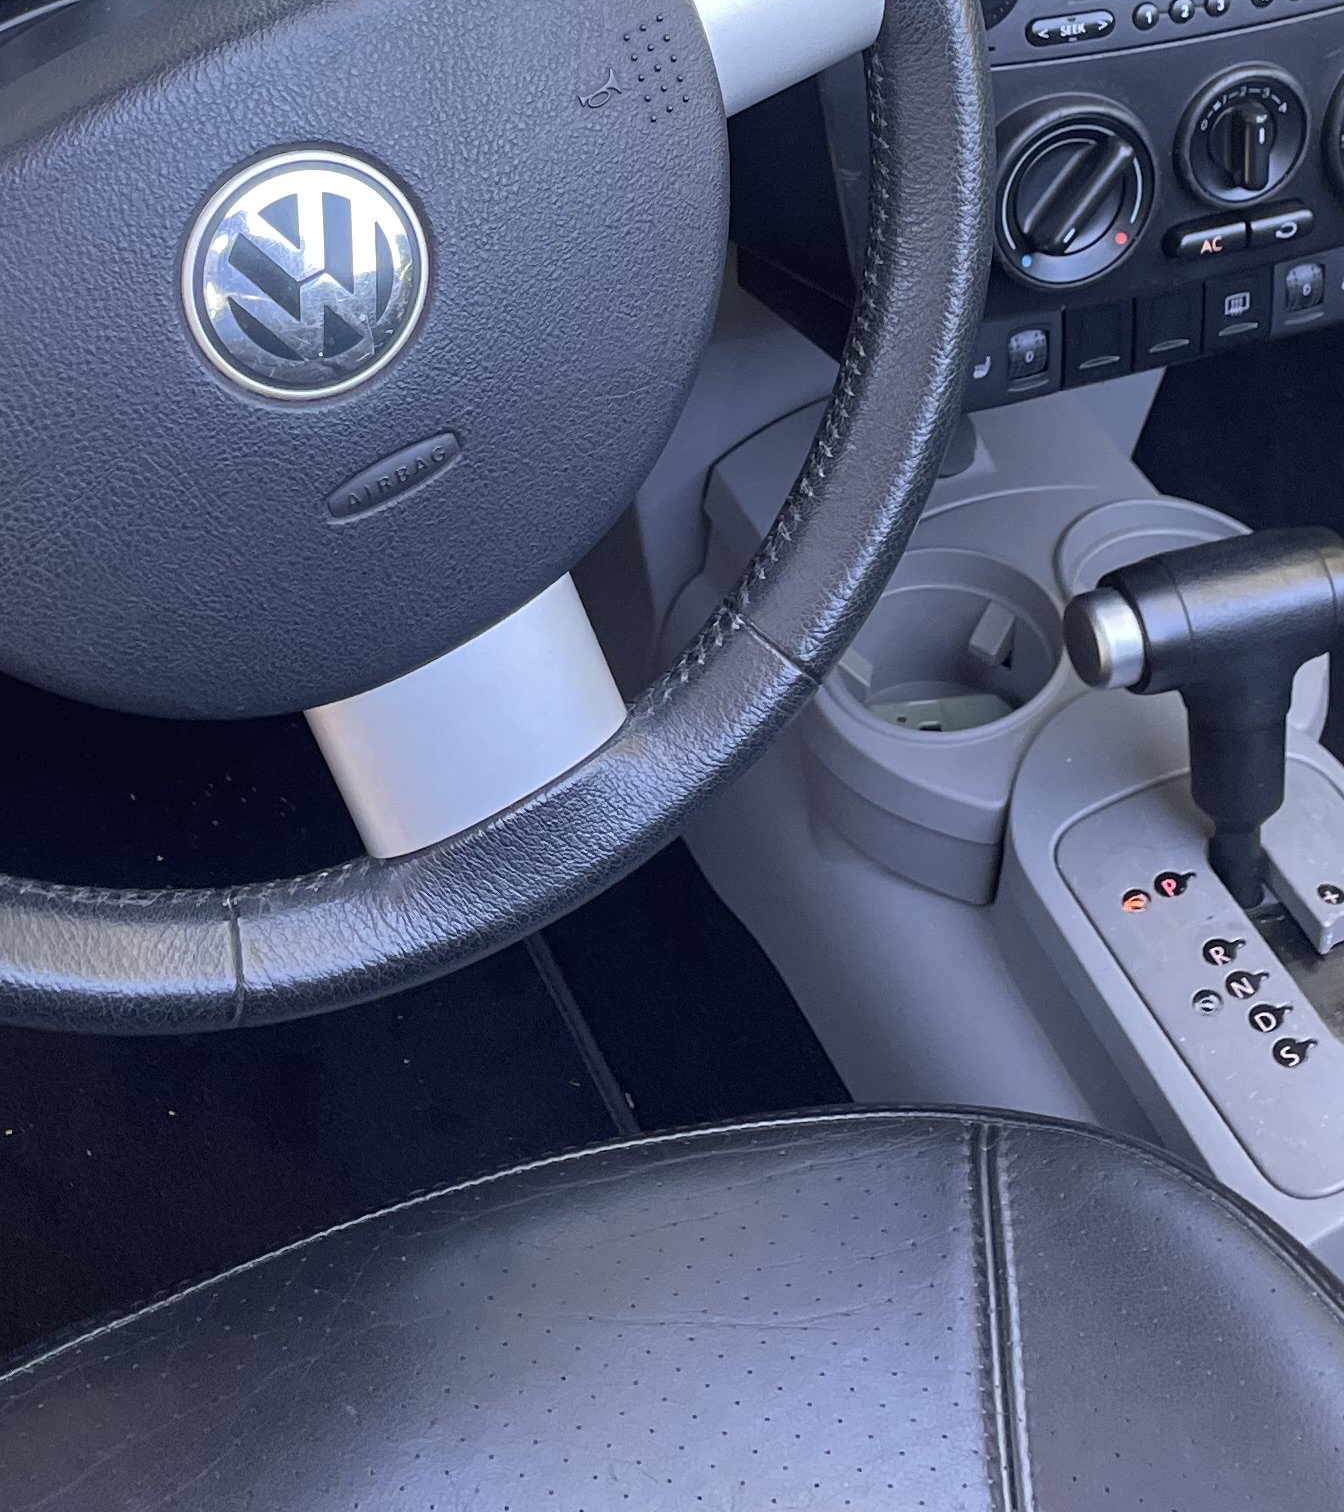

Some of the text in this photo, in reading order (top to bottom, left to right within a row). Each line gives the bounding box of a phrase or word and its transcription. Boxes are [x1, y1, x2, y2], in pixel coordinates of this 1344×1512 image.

[1200, 235, 1224, 255] AC
[348, 445, 446, 508] AIRBAG
[1160, 878, 1178, 897] P
[1208, 945, 1232, 967] R
[1230, 977, 1256, 1000] N
[1254, 1012, 1277, 1033] D
[1279, 1045, 1300, 1068] S
